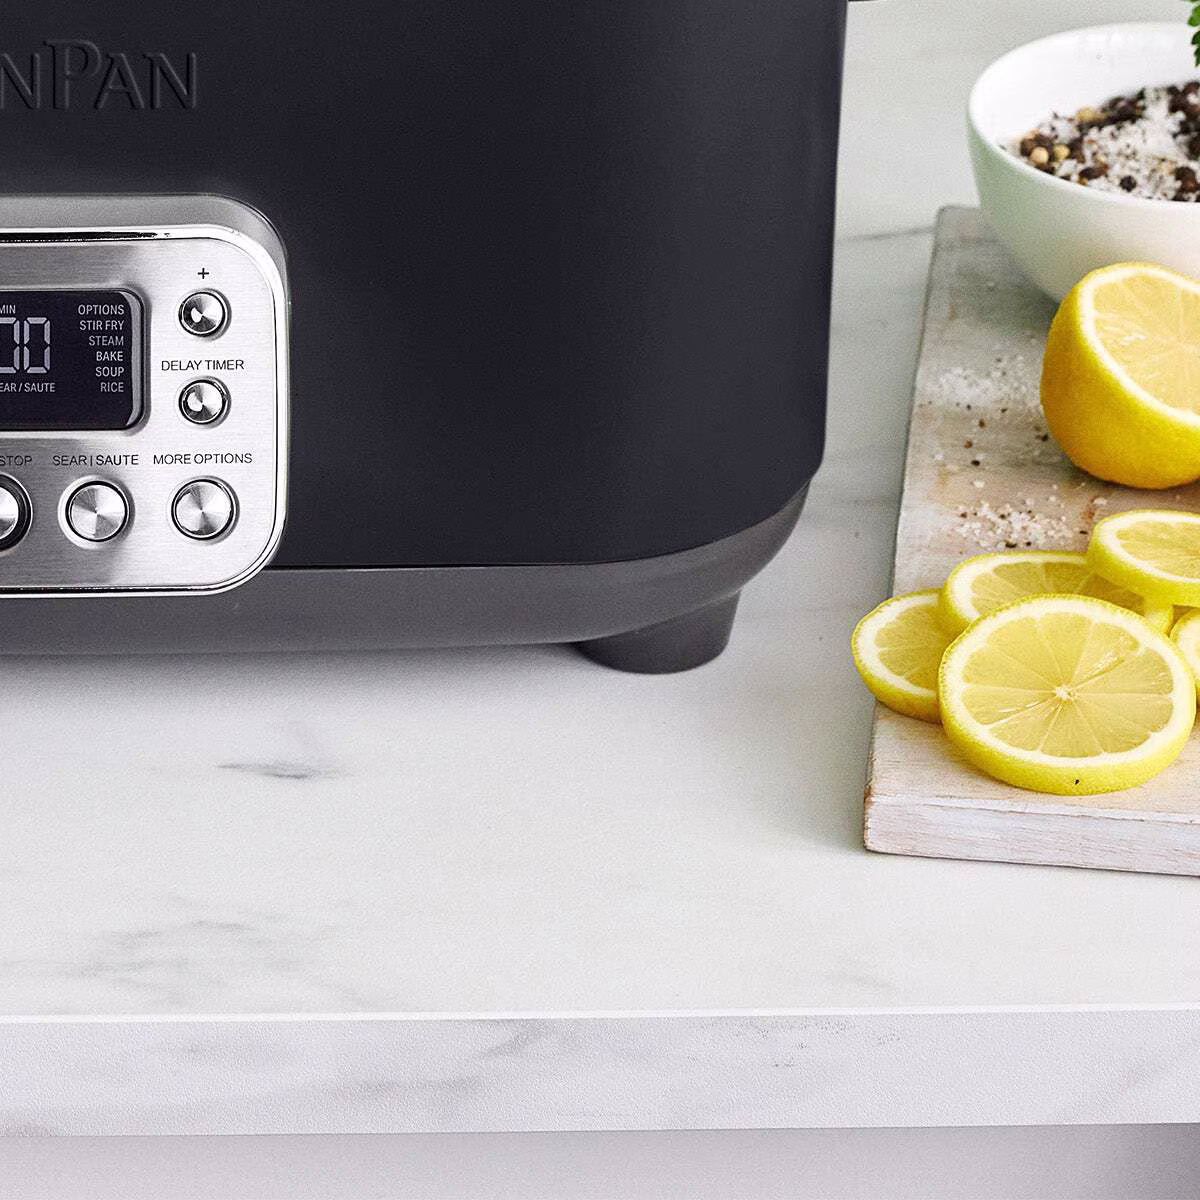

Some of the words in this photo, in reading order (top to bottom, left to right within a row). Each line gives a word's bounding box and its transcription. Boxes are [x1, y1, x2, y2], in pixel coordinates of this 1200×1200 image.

[78, 304, 125, 315] OPTIONS
[79, 320, 103, 331] STIR
[105, 320, 125, 331] FRY
[88, 335, 124, 346] STEAM
[96, 350, 124, 362] BAKE
[161, 360, 202, 371] DELAY
[205, 360, 244, 370] TIMER
[95, 366, 125, 377] SOUP
[24, 382, 56, 393] SAUTE
[100, 382, 125, 393] RICE
[52, 455, 88, 466] SEAR
[96, 455, 140, 466] SAUTE
[153, 453, 192, 465] MORE
[194, 453, 253, 465] OPTIONS
